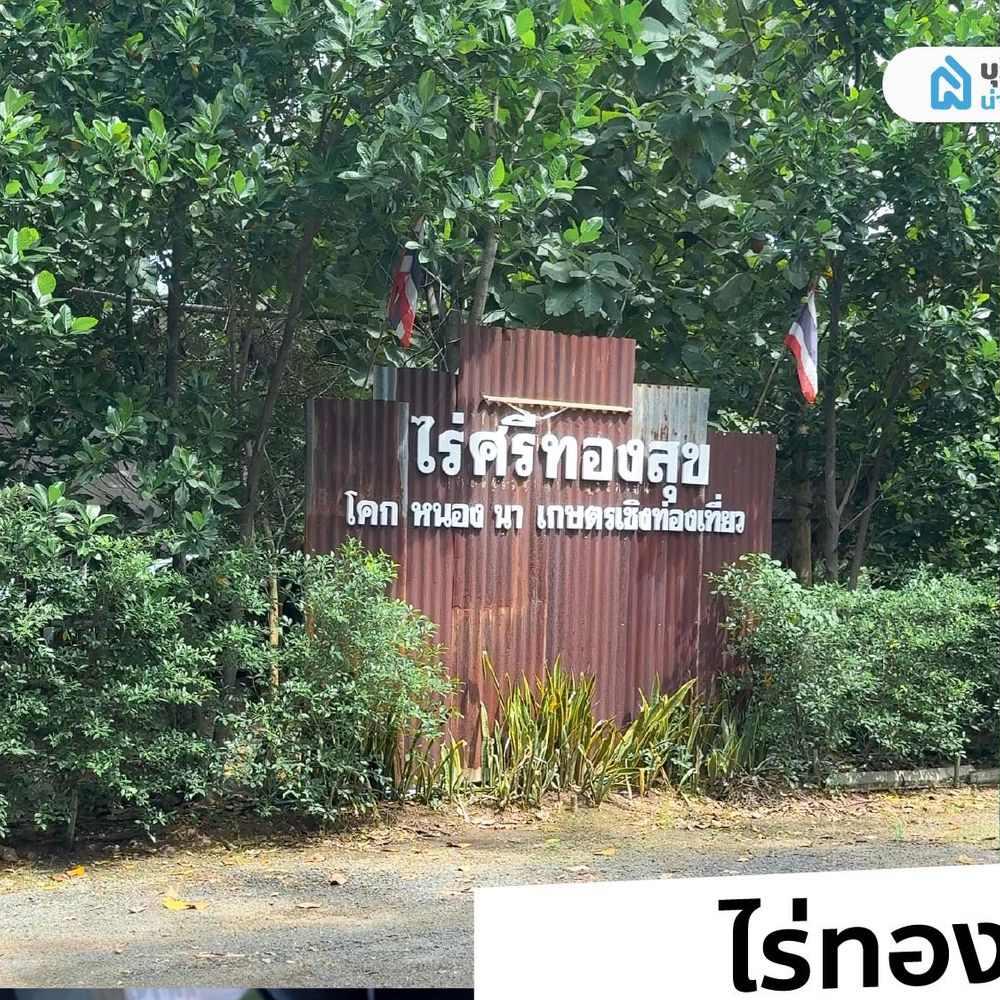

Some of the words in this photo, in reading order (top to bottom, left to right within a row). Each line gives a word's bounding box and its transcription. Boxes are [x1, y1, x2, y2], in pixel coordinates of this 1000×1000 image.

[411, 411, 710, 503] ไร่ศรีทองสุข
[344, 490, 398, 525] โคก
[410, 501, 485, 529] หนอง
[494, 504, 524, 530] นา
[536, 494, 745, 533] เกษตรเชิงท่องเที่ยว
